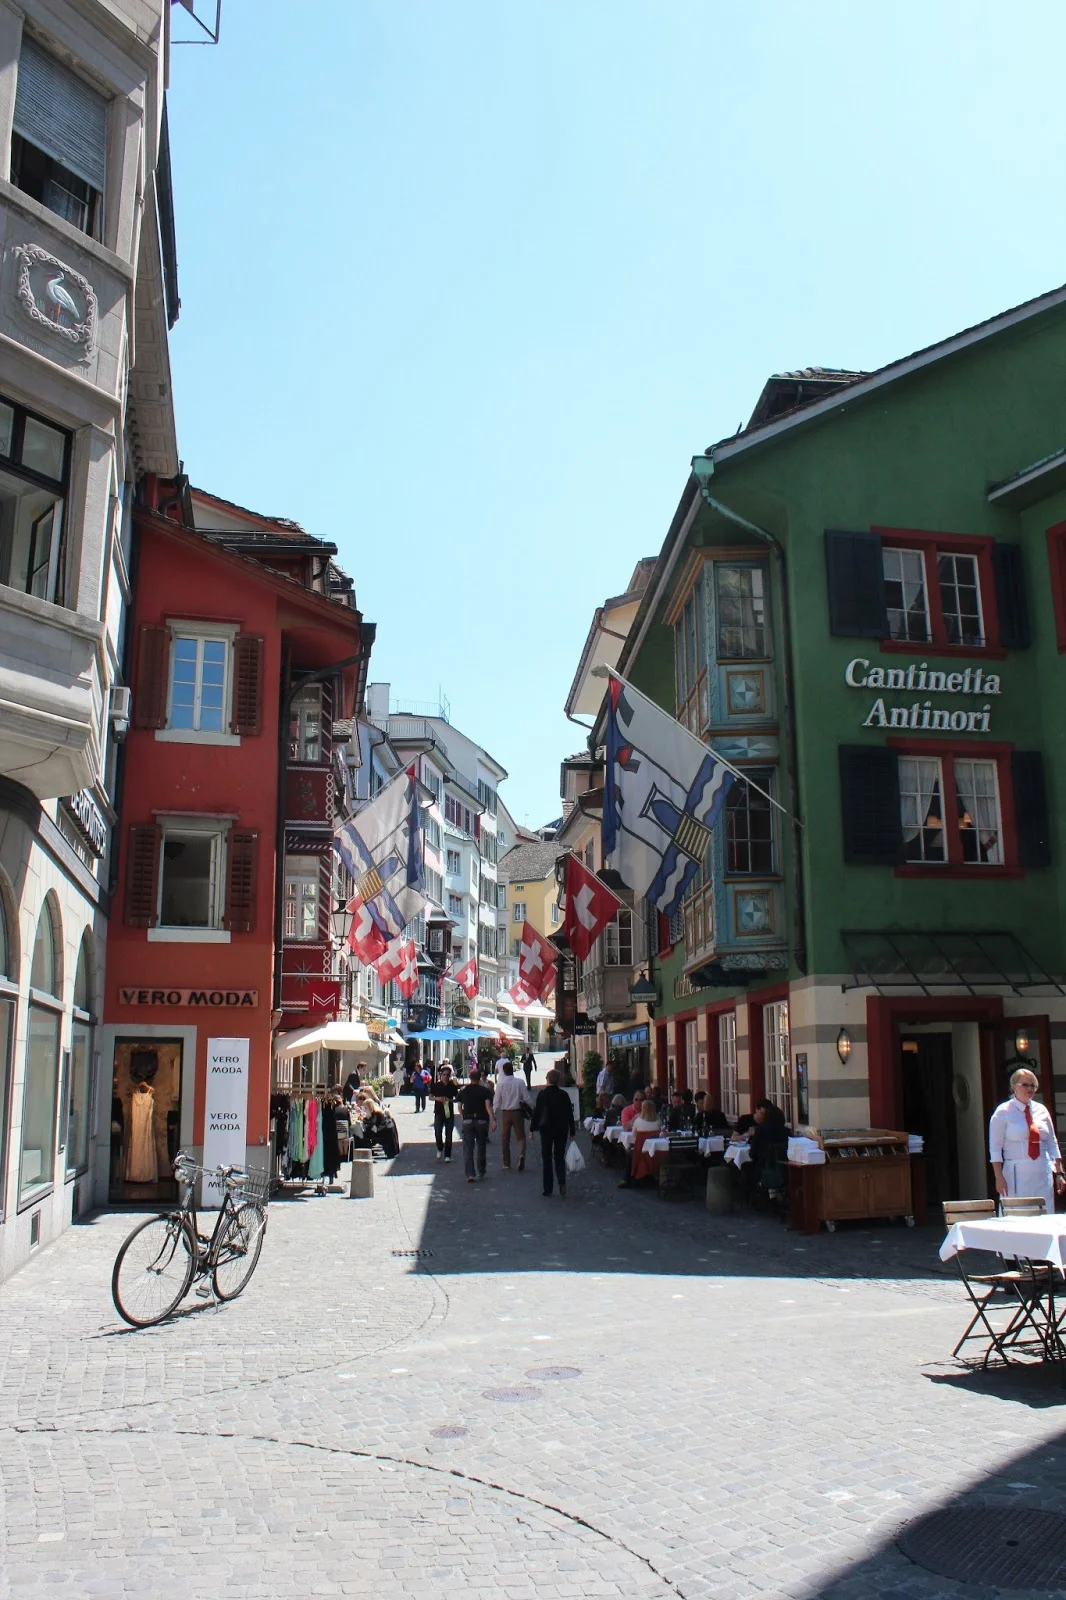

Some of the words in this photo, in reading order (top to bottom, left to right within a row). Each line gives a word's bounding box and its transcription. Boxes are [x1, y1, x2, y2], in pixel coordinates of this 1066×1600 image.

[845, 657, 1002, 695] Cantinetta
[861, 698, 991, 732] Antinori
[122, 990, 182, 1006] VERO
[211, 1066, 241, 1074] MODA
[210, 1112, 238, 1120] VERO
[209, 1123, 241, 1131] MODA
